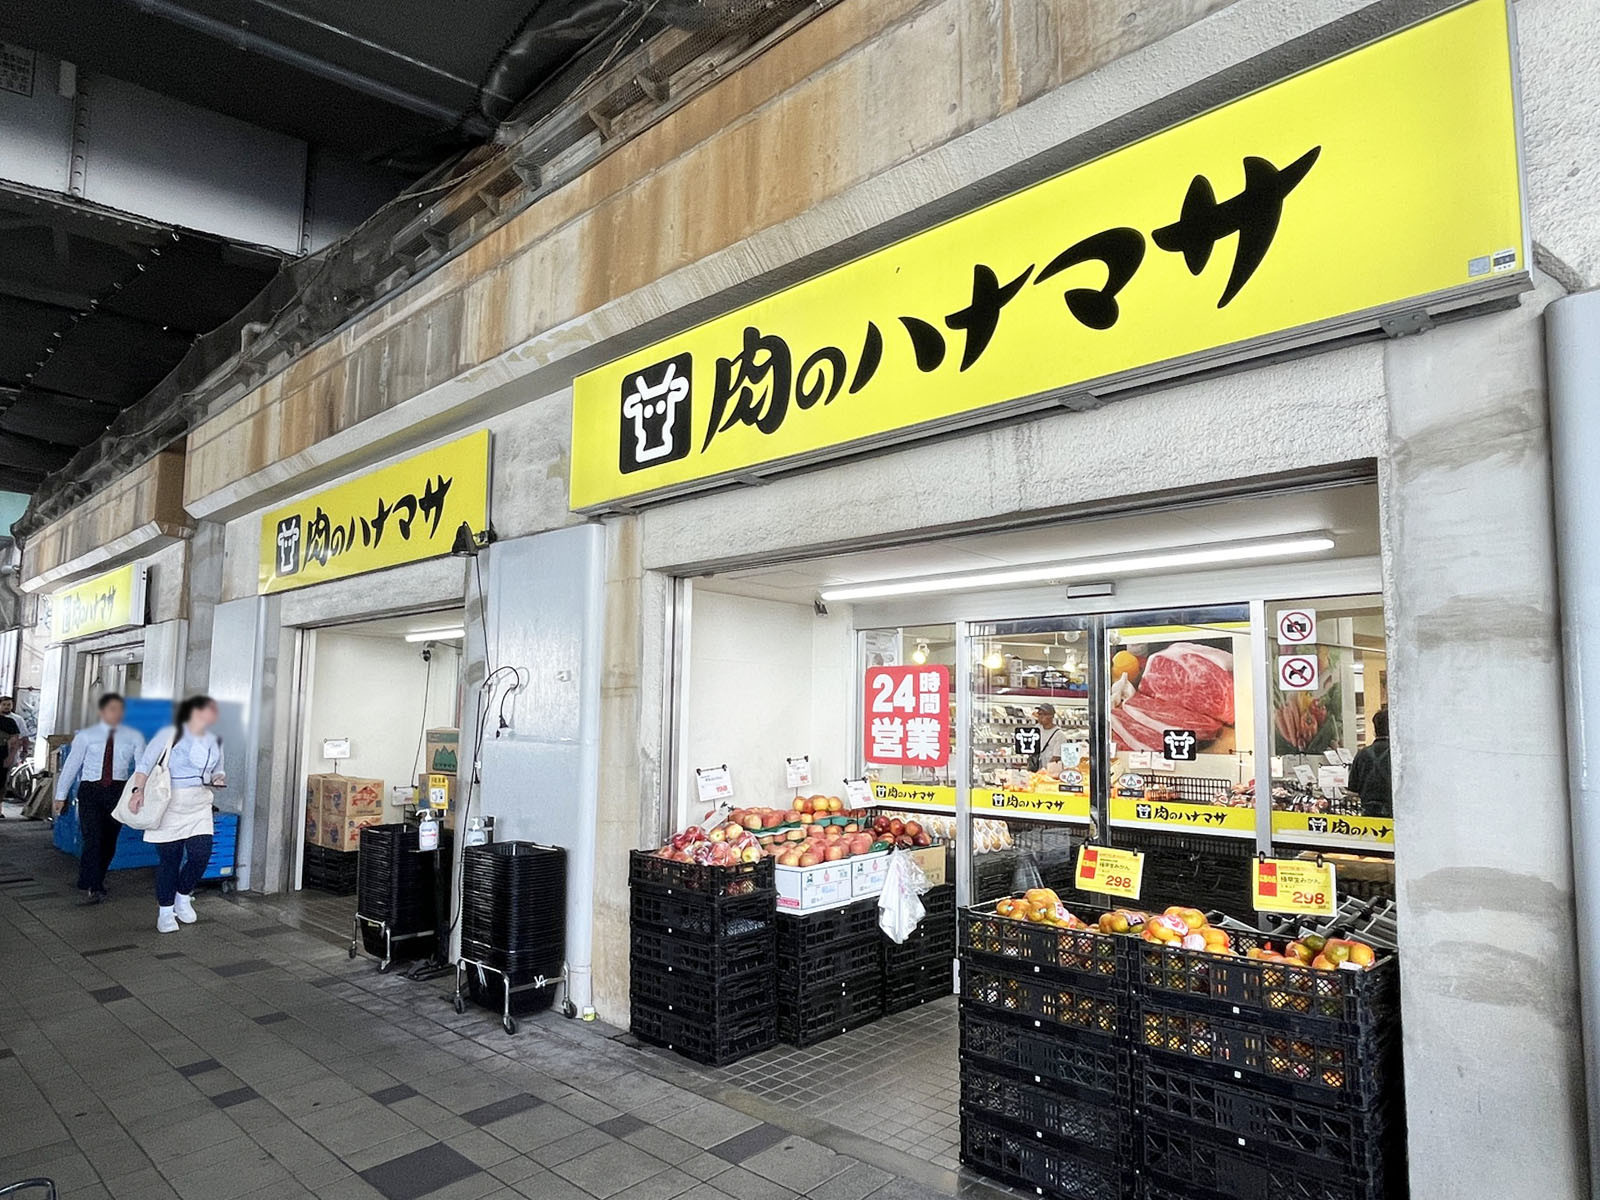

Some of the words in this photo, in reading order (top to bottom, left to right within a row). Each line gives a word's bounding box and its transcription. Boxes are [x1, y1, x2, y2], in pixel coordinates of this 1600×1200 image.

[701, 145, 1322, 455] 肉のハナマサ
[303, 474, 453, 571] 肉のハナマサ
[871, 716, 941, 761] 営業
[888, 786, 936, 801] 肉のハナマサ
[1006, 794, 1064, 811] 肉のハナマサ
[1153, 805, 1228, 825] 肉のハナマサ
[1105, 874, 1132, 889] 298
[1292, 891, 1325, 905] 298
